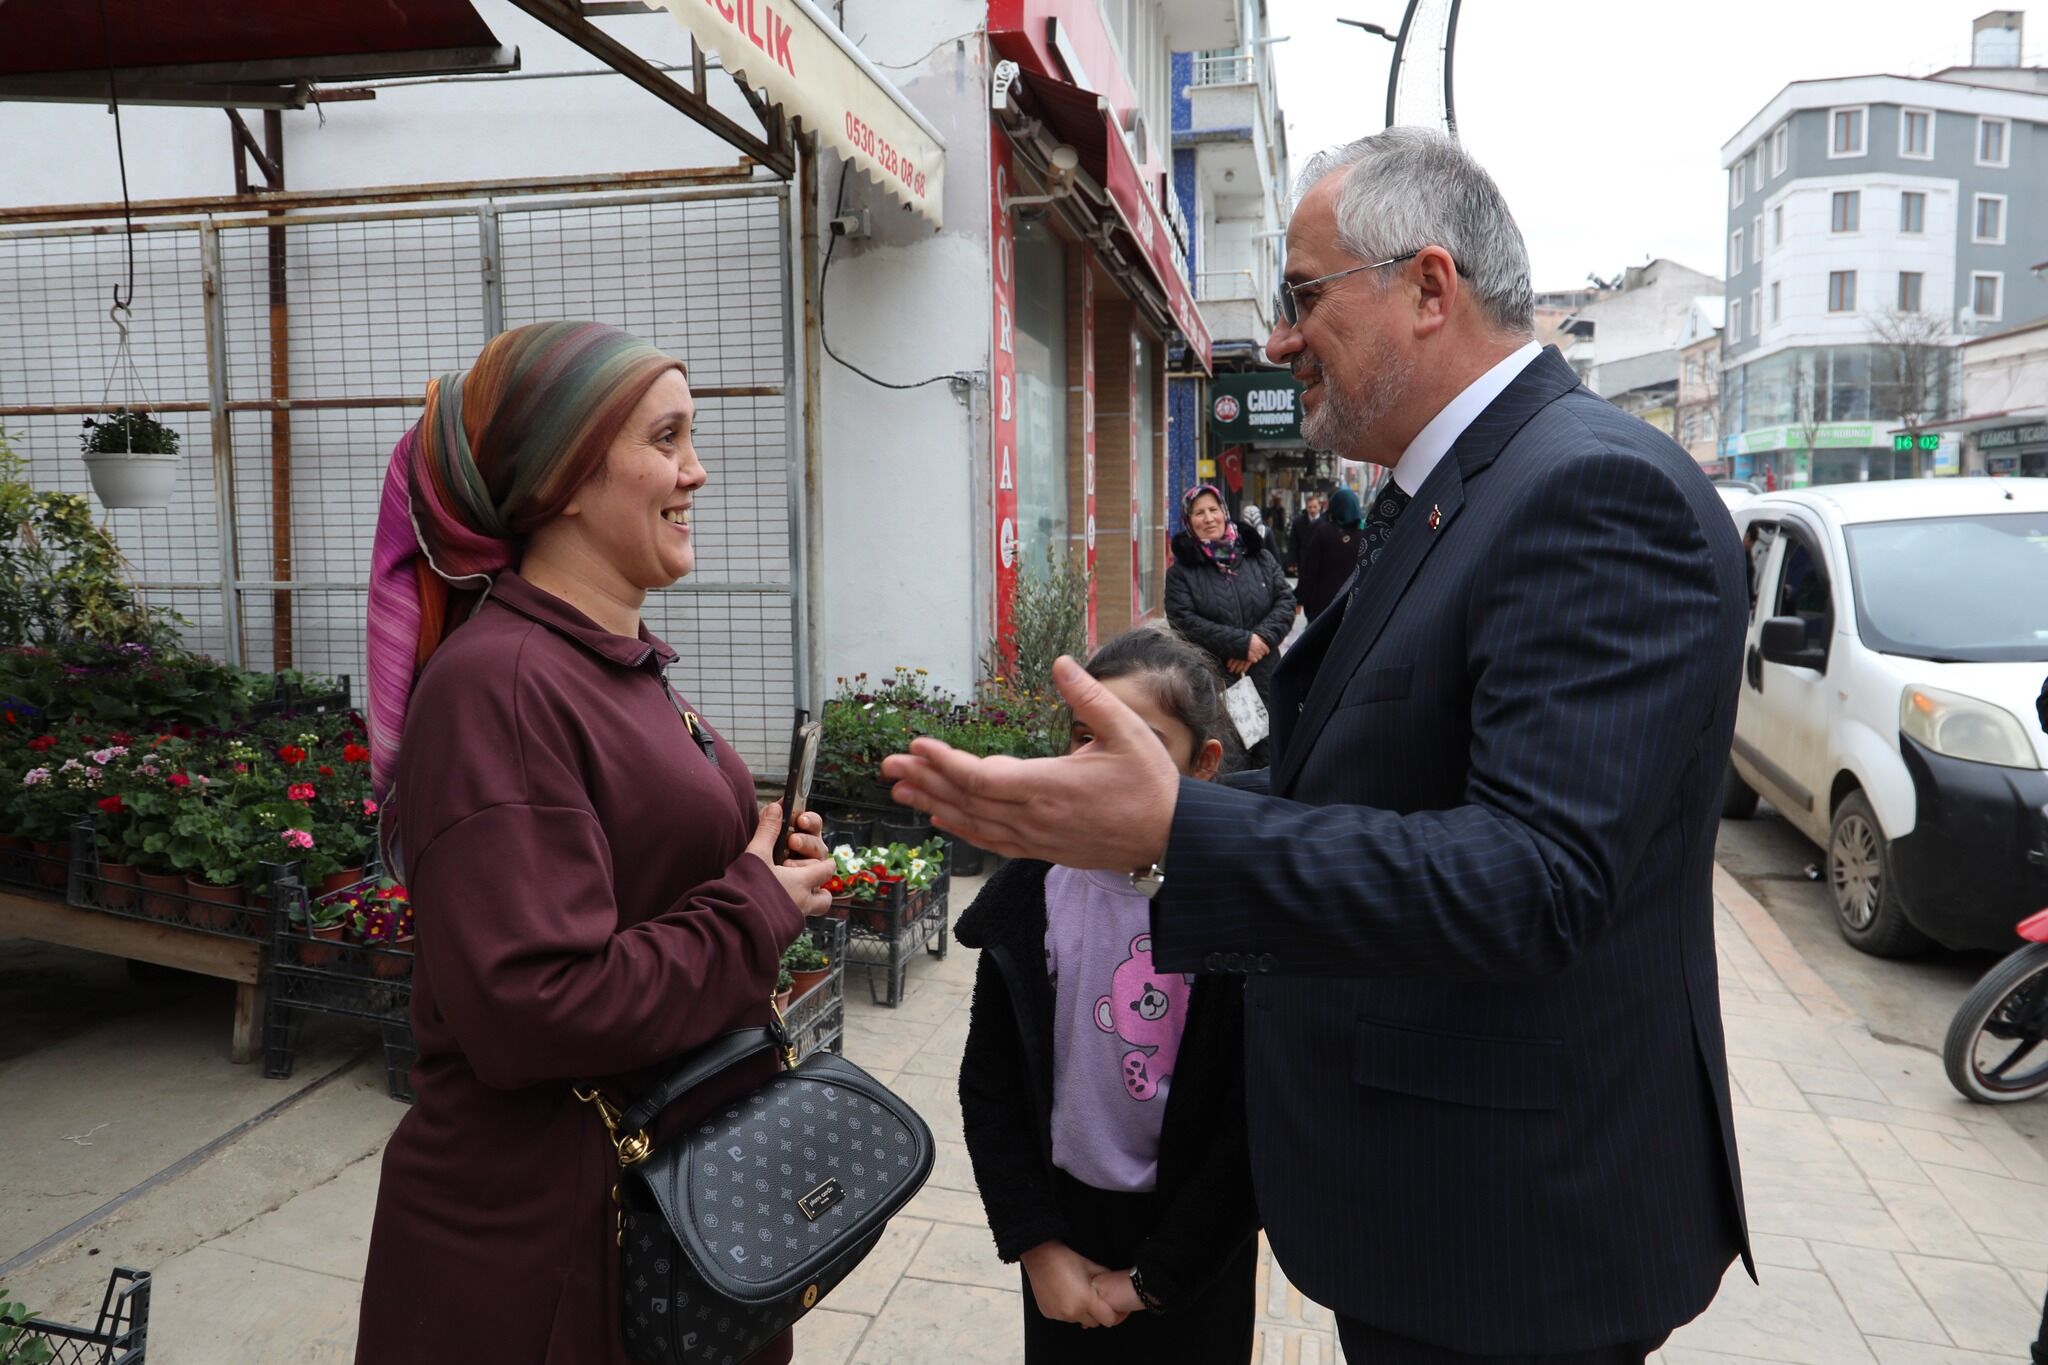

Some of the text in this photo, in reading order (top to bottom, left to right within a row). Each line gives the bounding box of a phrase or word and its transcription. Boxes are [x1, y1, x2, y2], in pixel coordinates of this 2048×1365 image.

[845, 111, 875, 158] 0530
[878, 138, 898, 176] 328
[901, 157, 913, 187] 08
[997, 164, 1013, 491] ÇORBA
[1247, 388, 1295, 412] CADDE
[1248, 412, 1294, 426] SHOWROOM
[1896, 436, 1938, 449] 16 02
